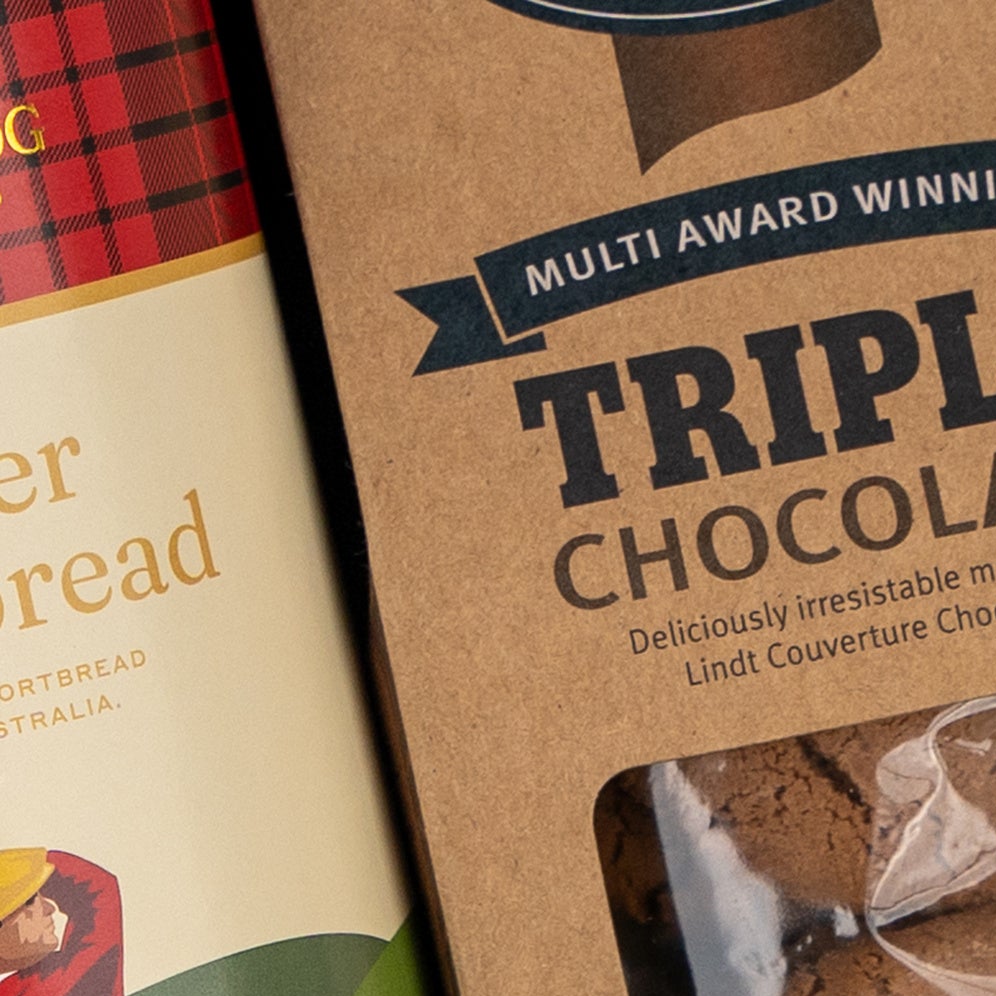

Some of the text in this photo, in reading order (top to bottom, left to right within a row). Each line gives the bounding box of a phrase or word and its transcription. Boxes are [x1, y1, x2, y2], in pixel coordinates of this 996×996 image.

[0, 104, 45, 155] G
[524, 228, 662, 296] MULTI
[677, 191, 838, 252] AWARD
[0, 436, 81, 514] er
[0, 488, 221, 630] read
[629, 601, 788, 654] Deliciously
[796, 566, 960, 620] irresistable
[0, 649, 146, 702] ORTBREAD
[685, 650, 760, 686] Lindt
[767, 619, 928, 669] Couverture
